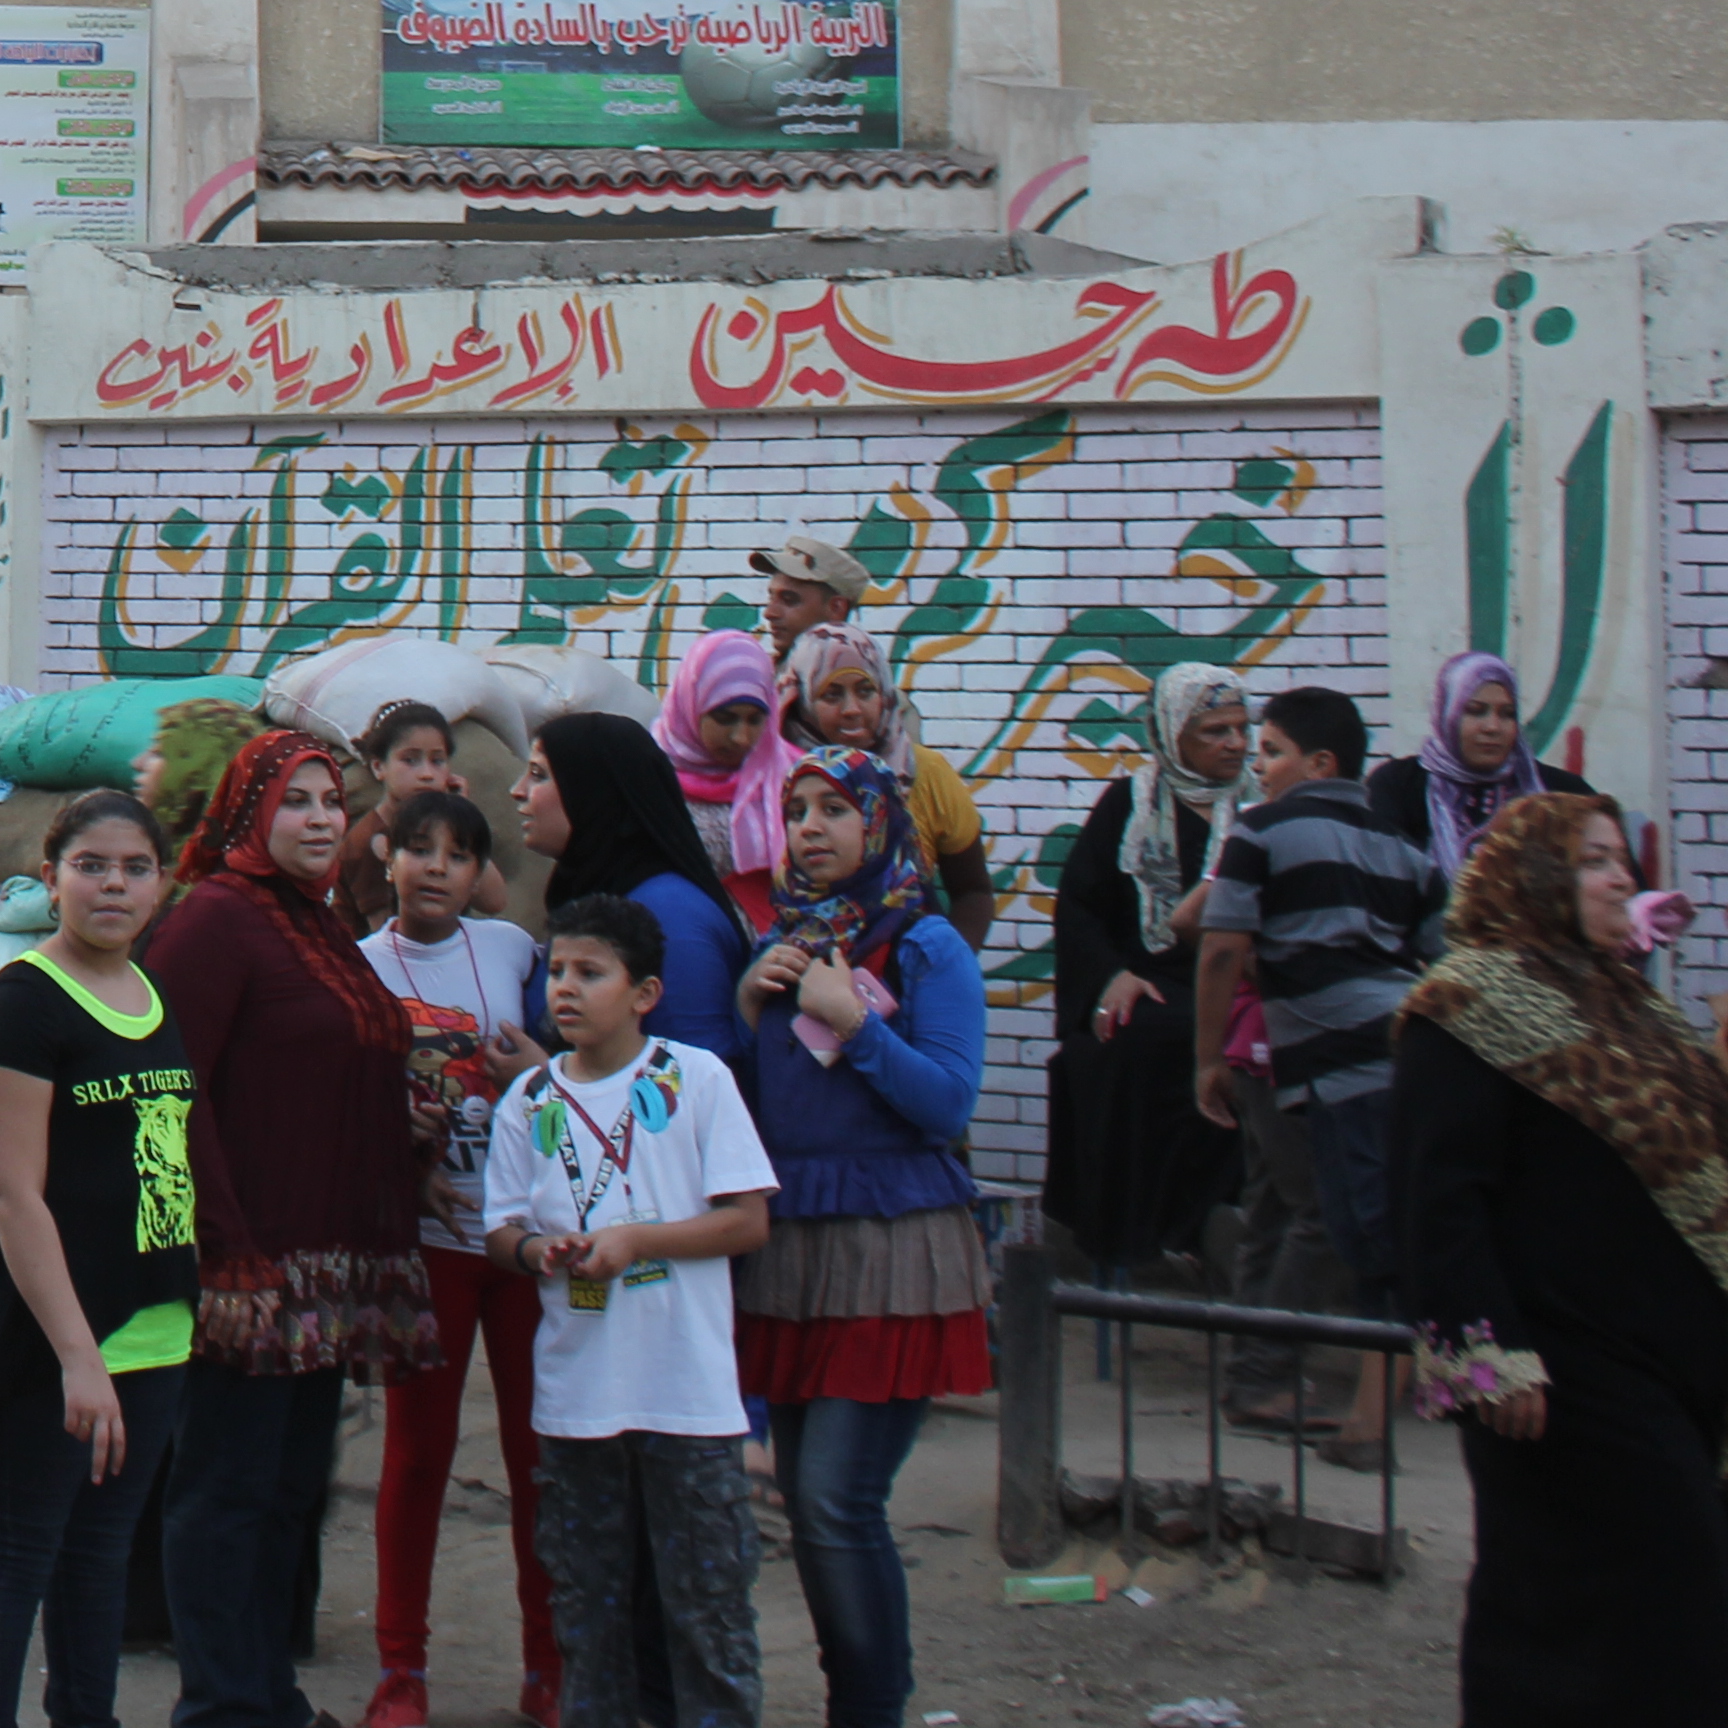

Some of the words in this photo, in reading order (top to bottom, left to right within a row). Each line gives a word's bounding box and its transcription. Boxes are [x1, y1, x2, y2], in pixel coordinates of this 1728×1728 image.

[397, 0, 507, 55] الضيوف
[511, 0, 614, 56] بالسادة
[611, 3, 691, 58] ترحب
[808, 0, 889, 59] التربية
[246, 292, 618, 408] الإعدادية
[689, 280, 1157, 410] حسين
[1114, 251, 1306, 400] طه
[96, 322, 248, 410] بنين
